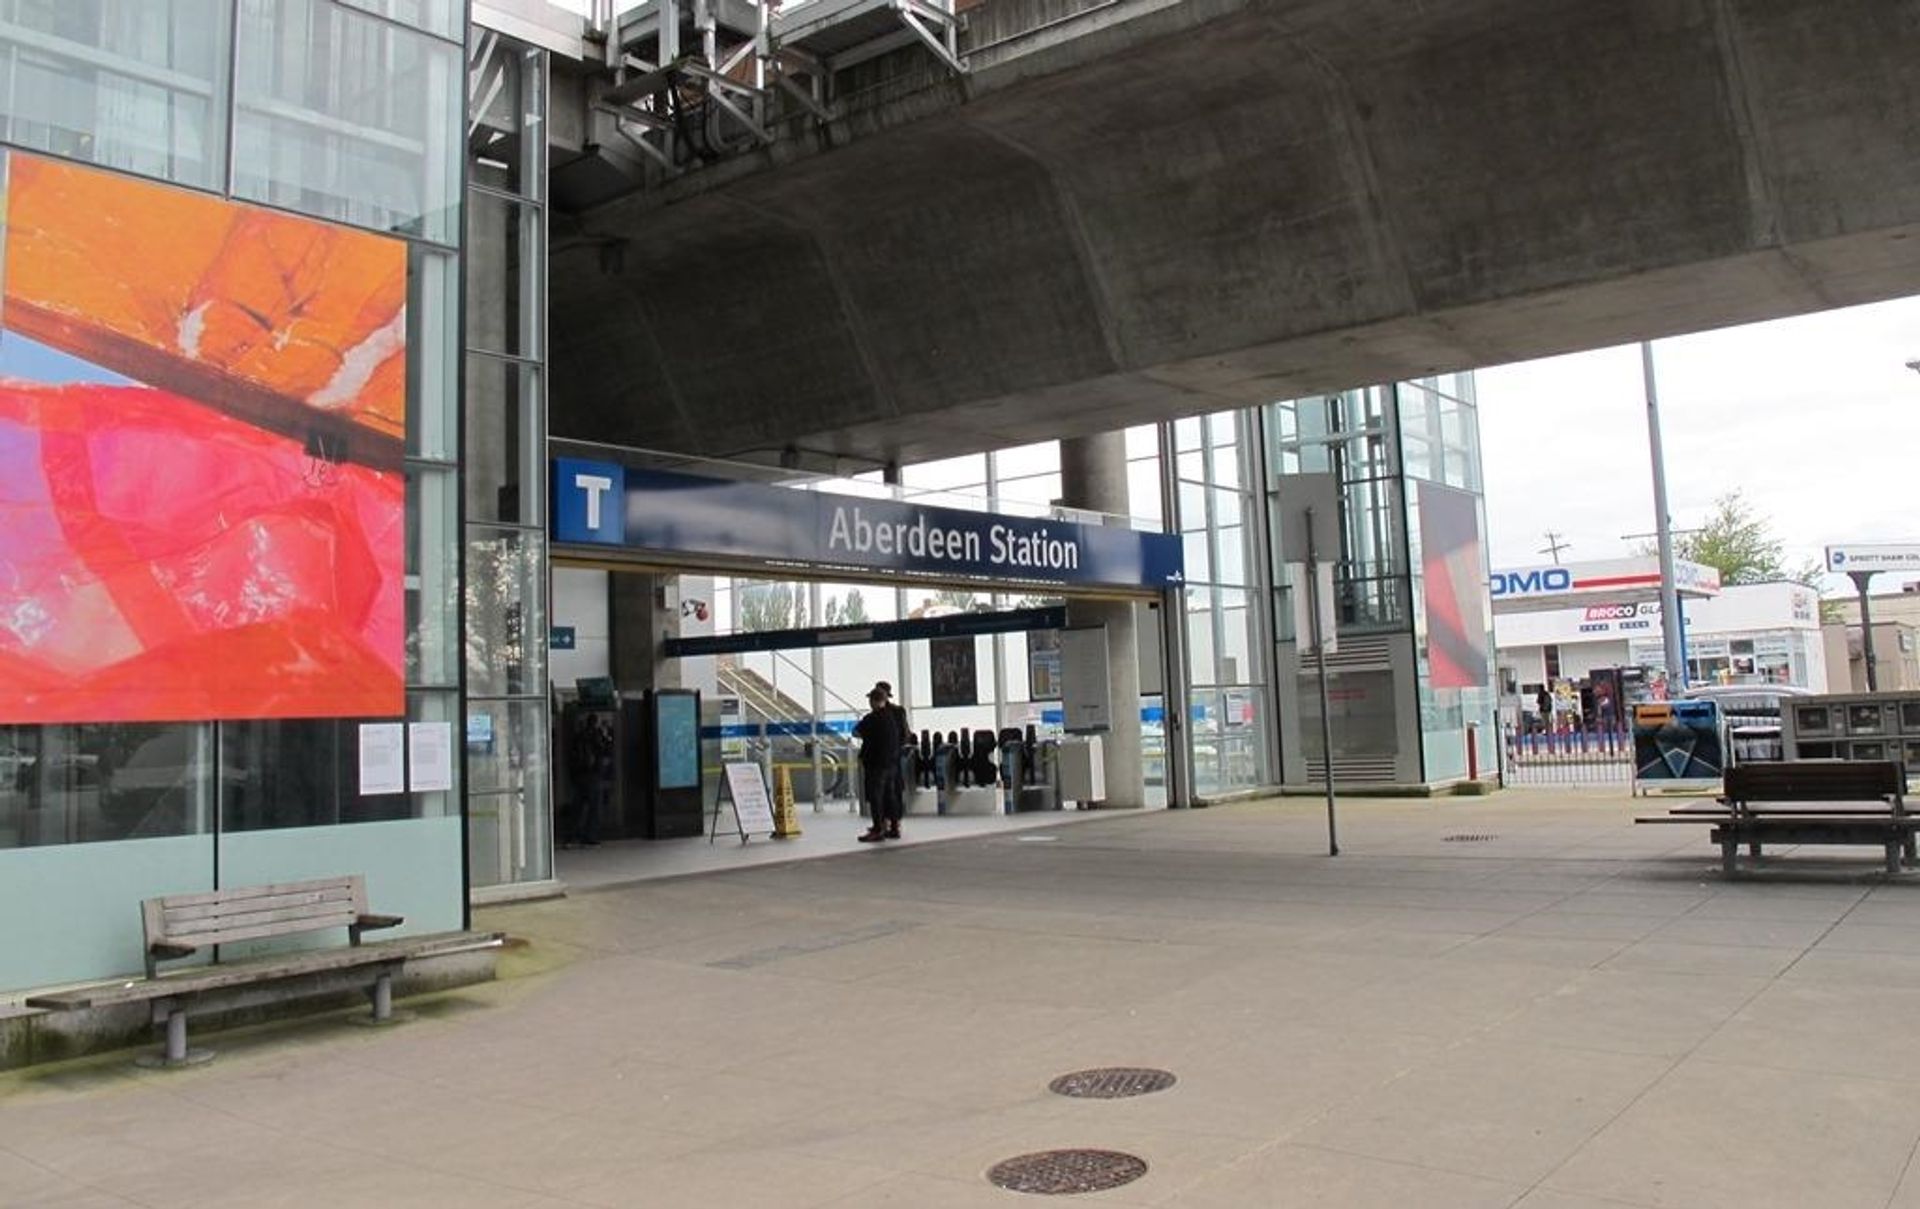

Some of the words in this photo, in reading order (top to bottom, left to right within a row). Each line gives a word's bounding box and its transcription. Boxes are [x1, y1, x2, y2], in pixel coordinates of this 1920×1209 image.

[576, 474, 613, 530] T
[828, 506, 980, 562] Aberdeen
[990, 525, 1079, 570] Station
[1589, 606, 1634, 619] BROCO
